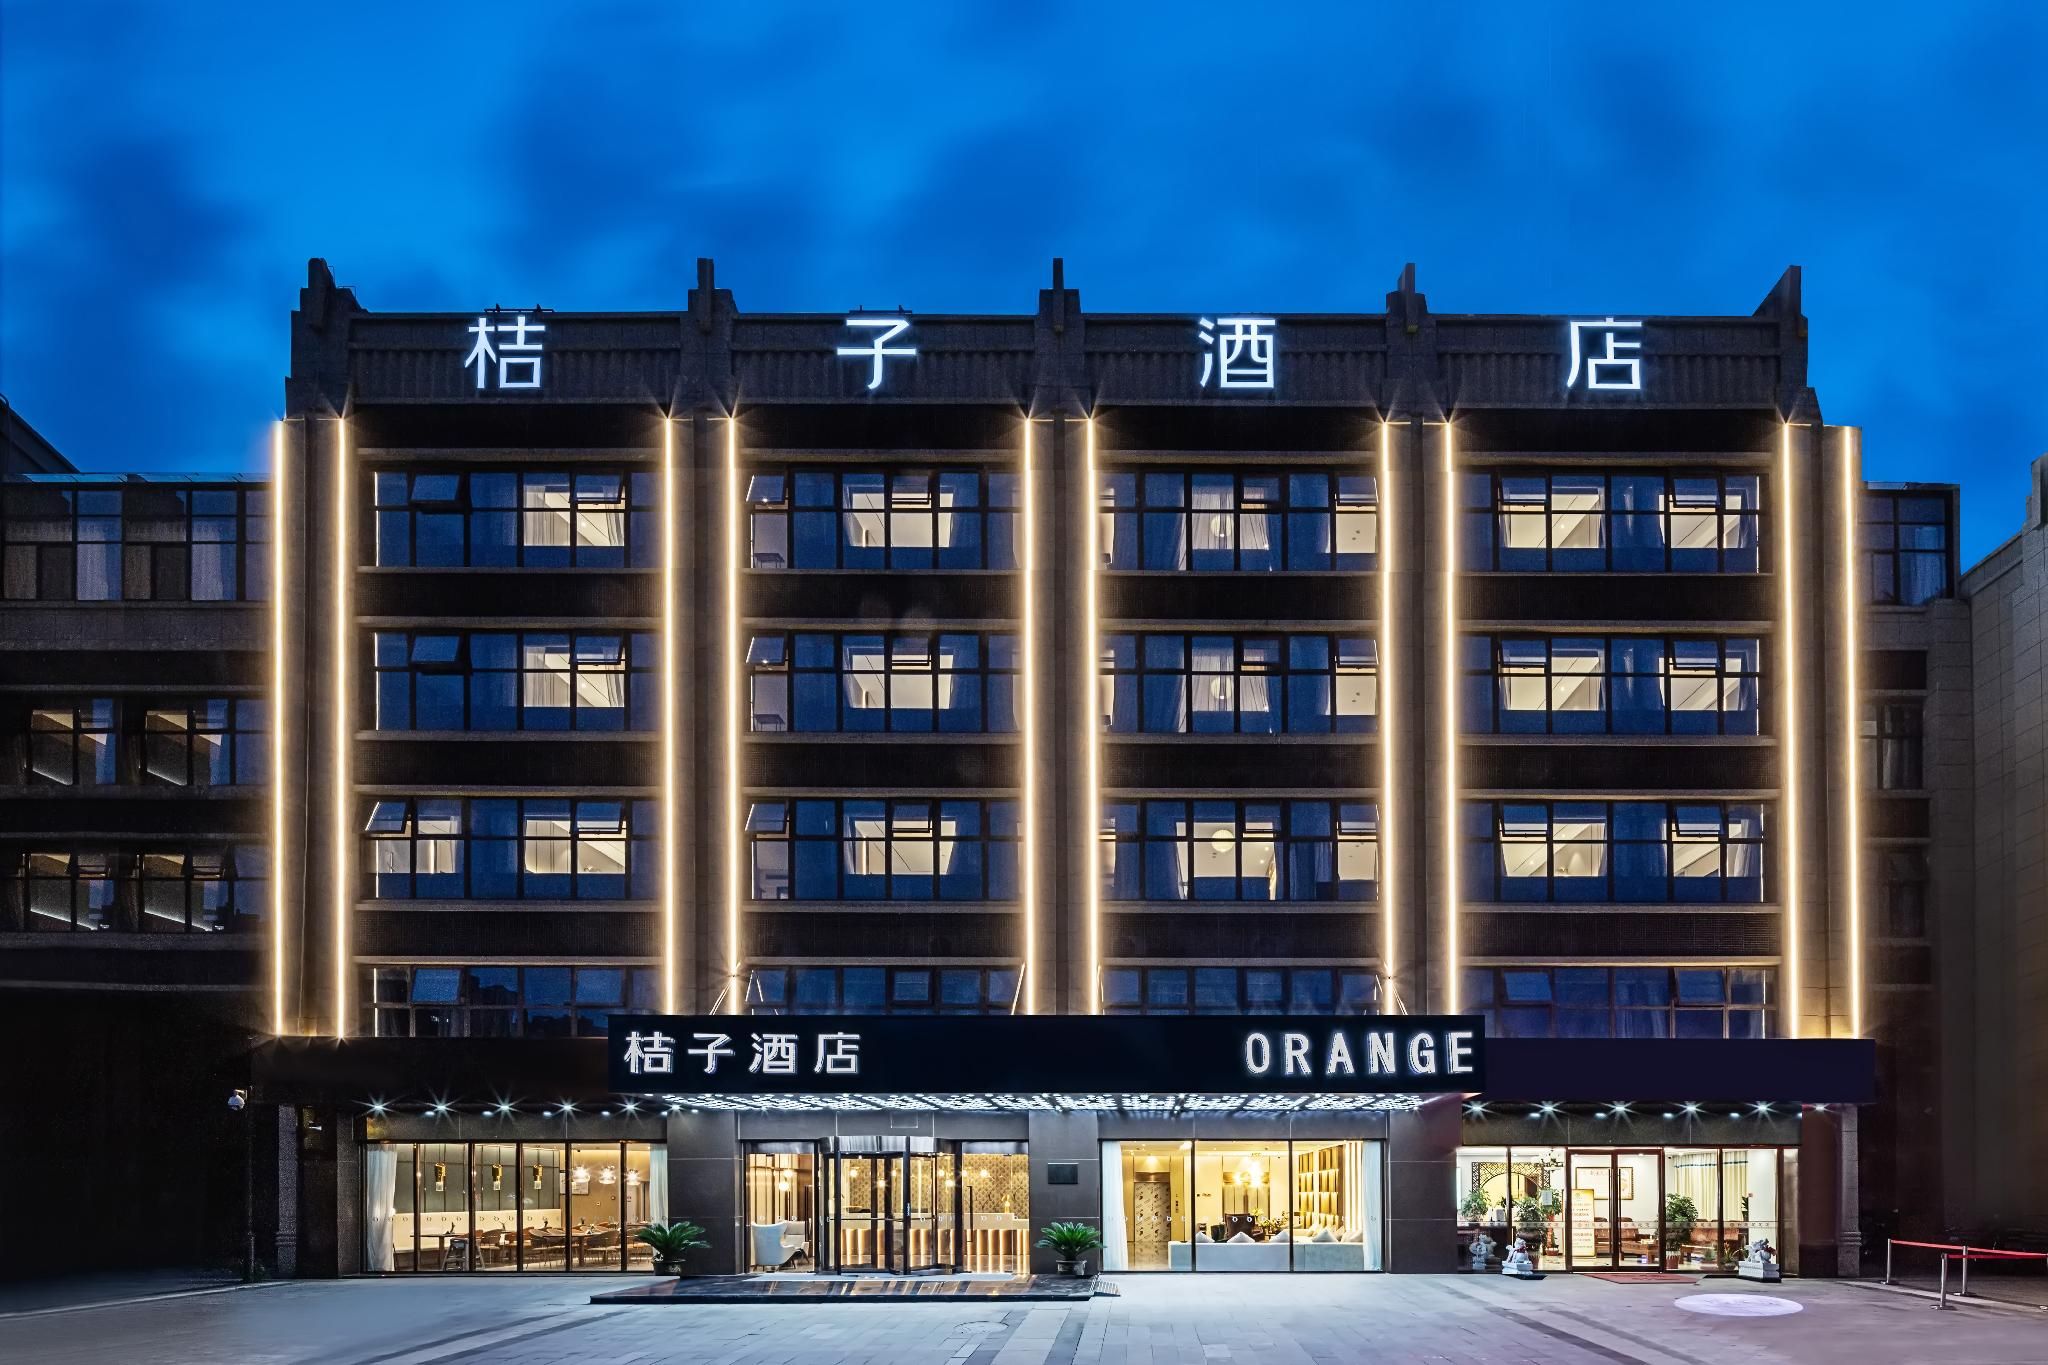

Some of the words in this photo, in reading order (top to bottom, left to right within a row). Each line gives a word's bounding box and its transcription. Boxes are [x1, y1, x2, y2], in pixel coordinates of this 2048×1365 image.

[464, 316, 1643, 390] 桔子酒店
[623, 1031, 861, 1075] 桔子酒店
[1244, 1031, 1474, 1075] ORANGE
